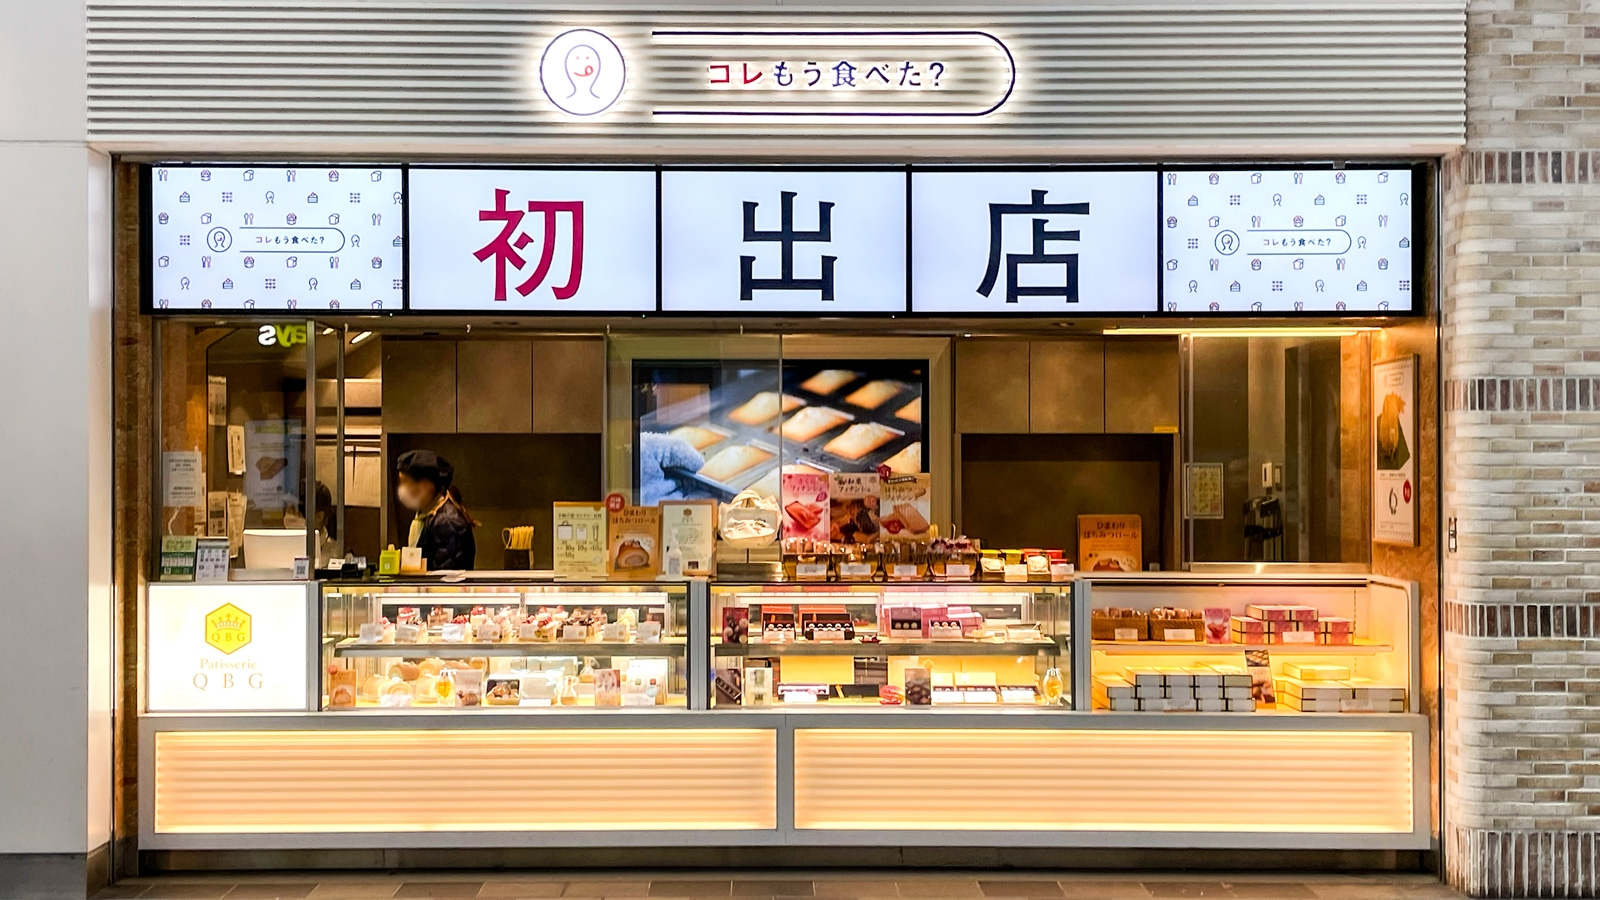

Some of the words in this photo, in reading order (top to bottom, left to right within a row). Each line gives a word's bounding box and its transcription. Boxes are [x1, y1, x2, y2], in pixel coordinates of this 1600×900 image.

[707, 60, 945, 88] コレもう食べた？
[255, 235, 325, 245] コレもう食べた？
[473, 188, 1091, 304] 初出店
[1263, 237, 1332, 247] コレもう食べた？
[200, 658, 257, 670] Patisserie
